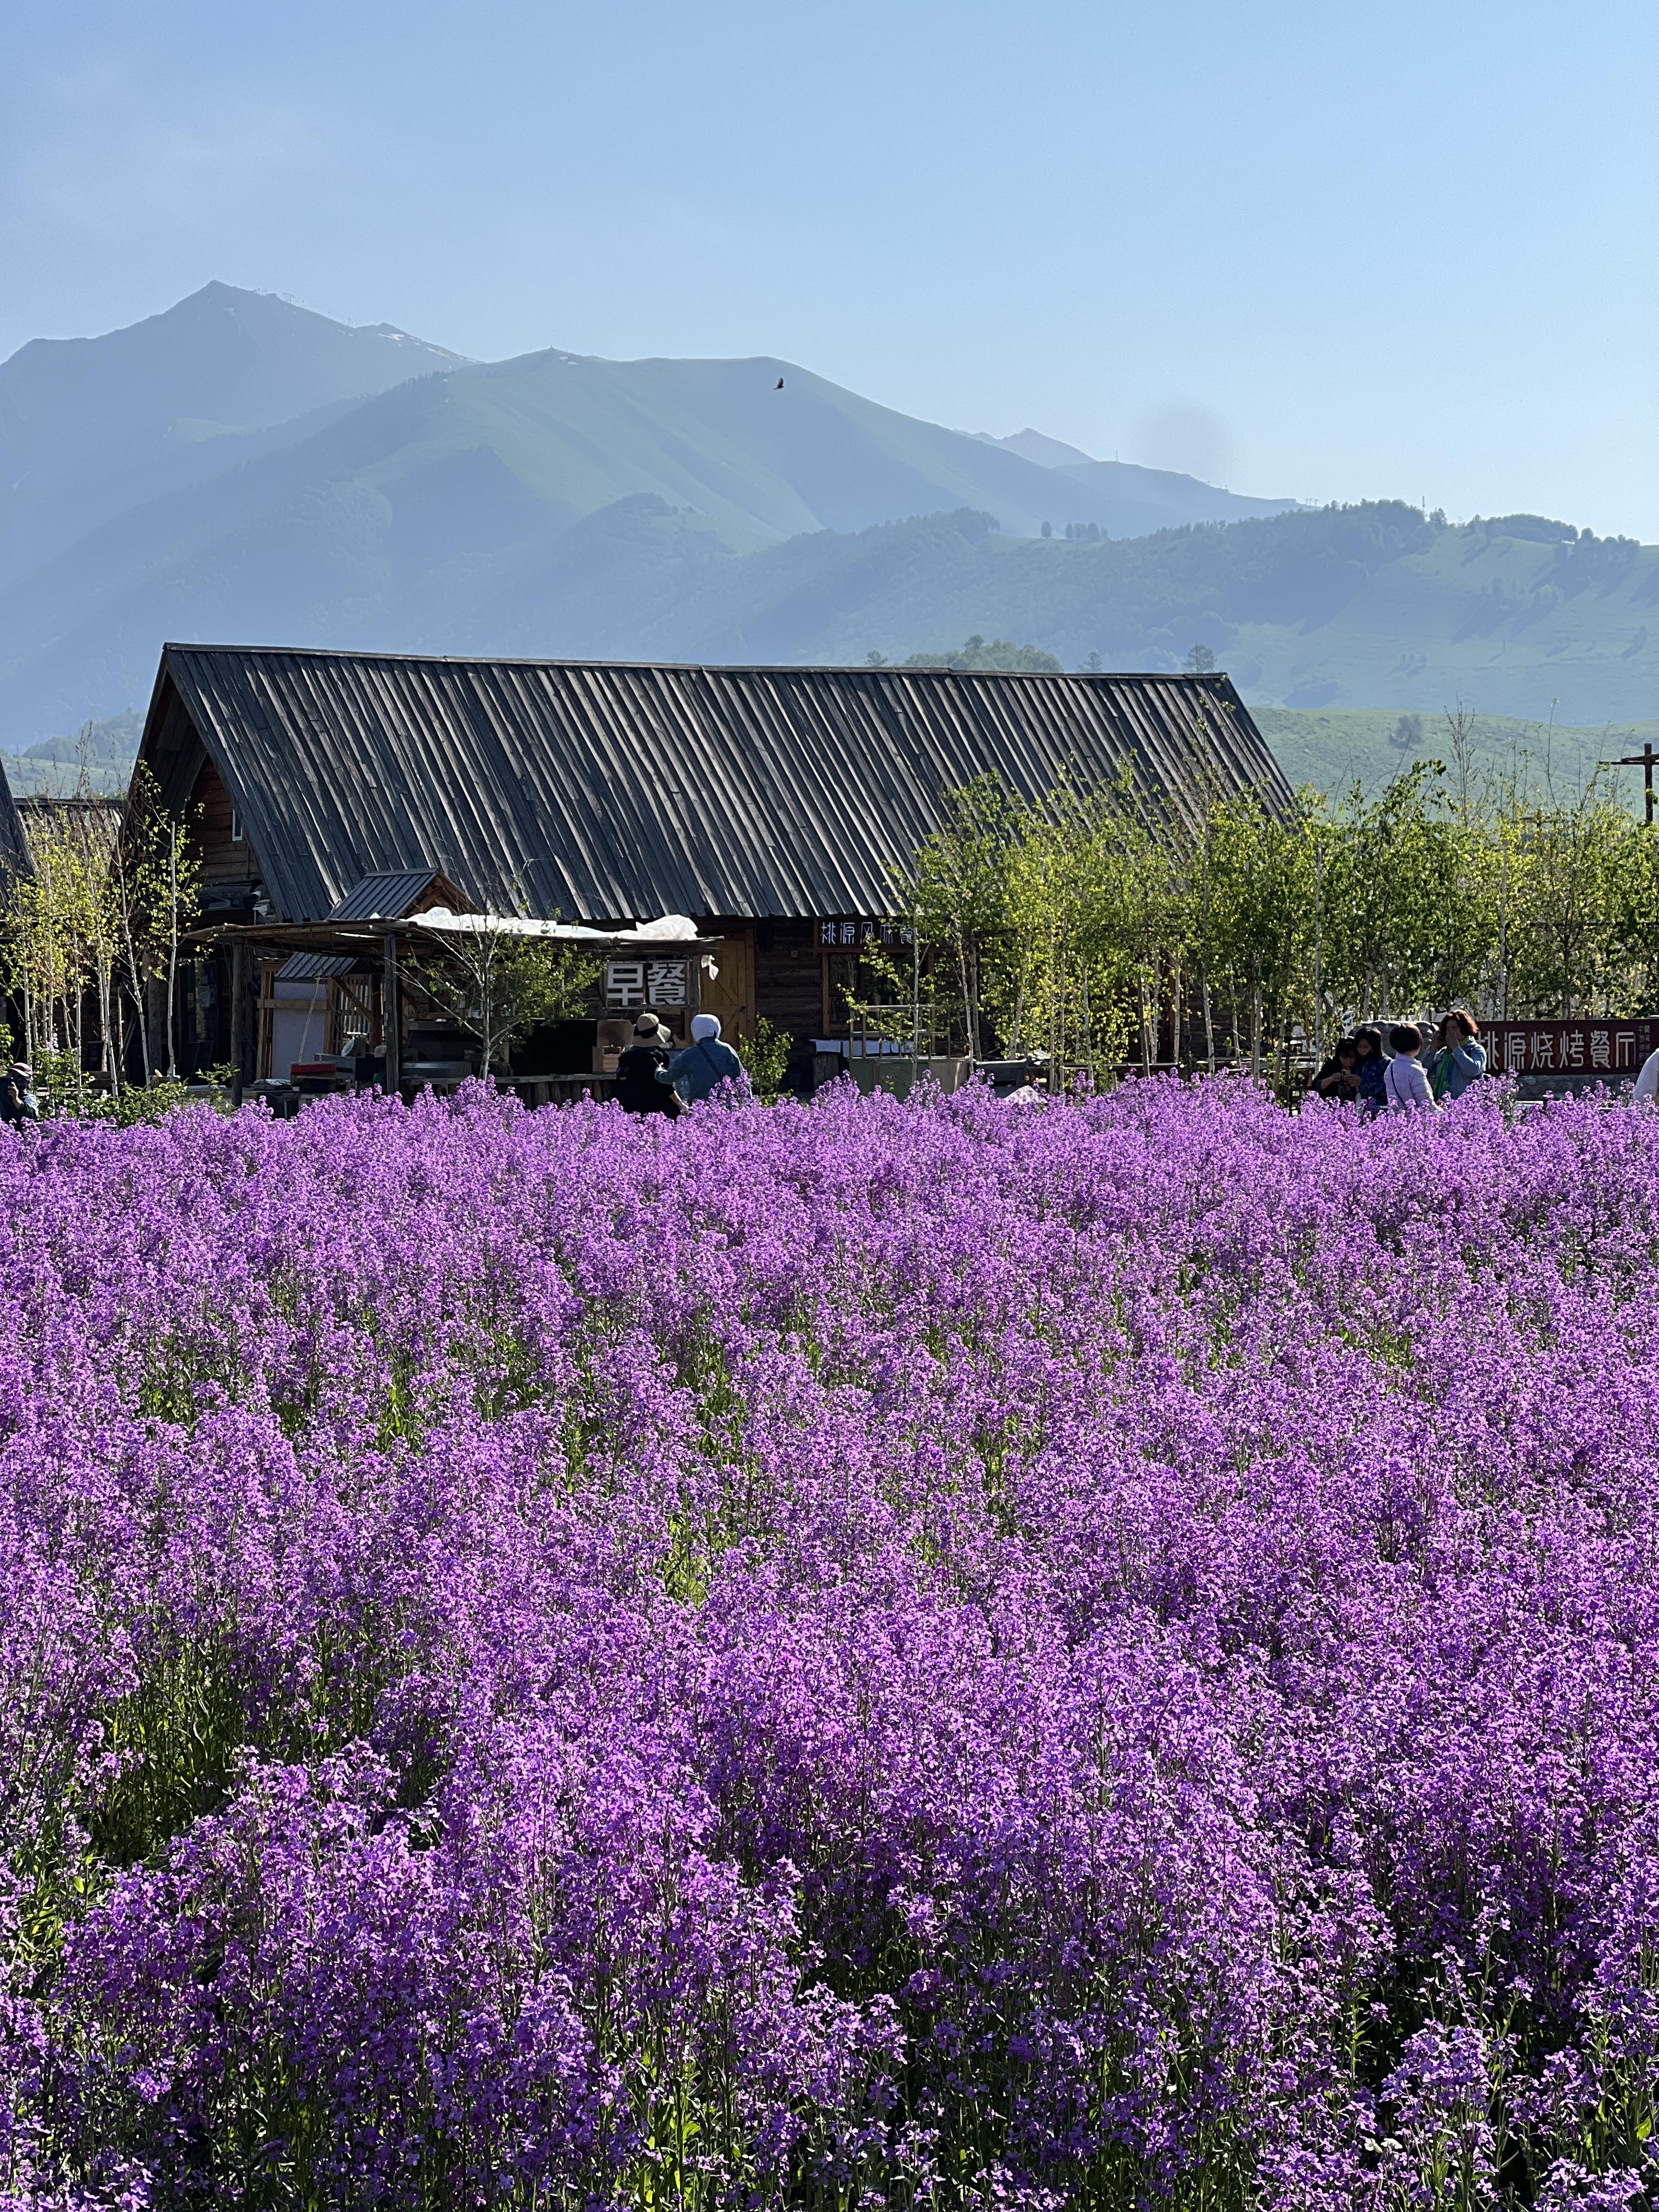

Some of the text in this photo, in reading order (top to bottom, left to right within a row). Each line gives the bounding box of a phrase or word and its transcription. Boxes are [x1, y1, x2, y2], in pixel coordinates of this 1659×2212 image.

[607, 962, 686, 1006] 早餐
[1477, 1029, 1636, 1069] 桃源烧烤餐厅
